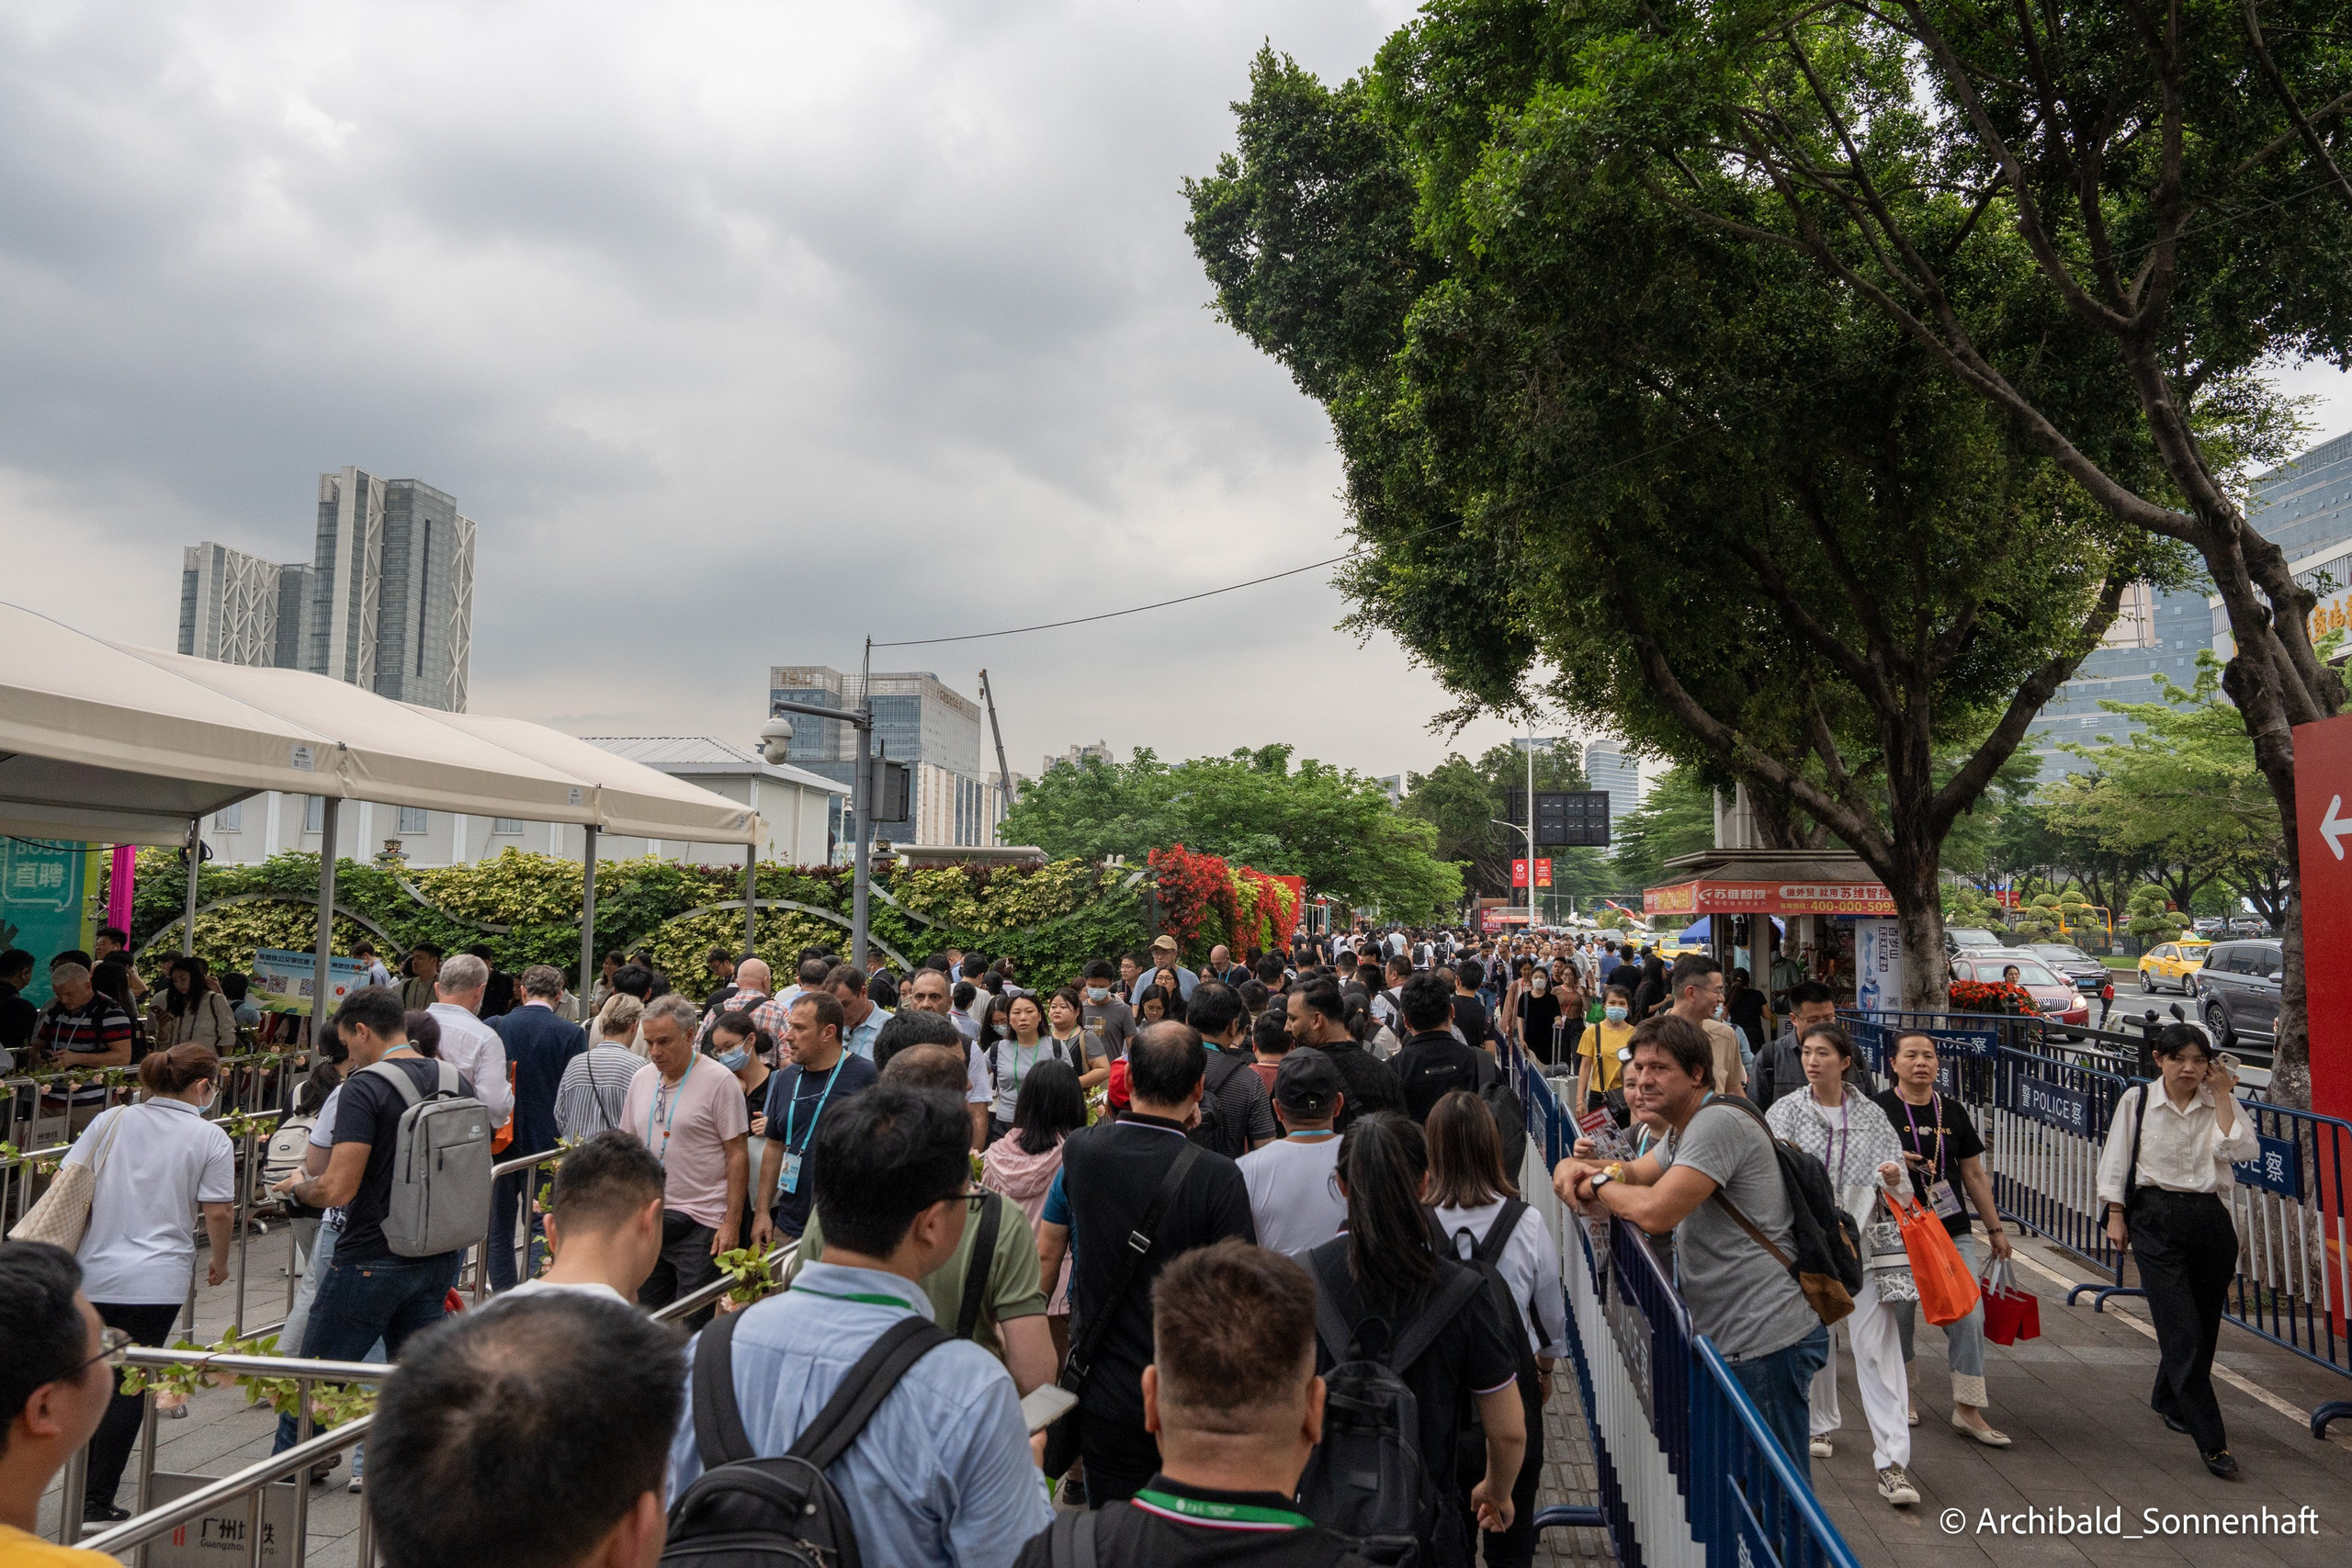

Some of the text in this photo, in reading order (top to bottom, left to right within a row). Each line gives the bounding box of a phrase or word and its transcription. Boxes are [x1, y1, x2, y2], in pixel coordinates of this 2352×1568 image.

[16, 838, 66, 855] BOSS
[14, 861, 64, 887] 直聘
[1713, 888, 1766, 900] 苏维智搜
[1786, 887, 1815, 897] 做外贸
[2022, 1083, 2082, 1126] 警 POLICE 察
[2266, 1150, 2284, 1184] 察
